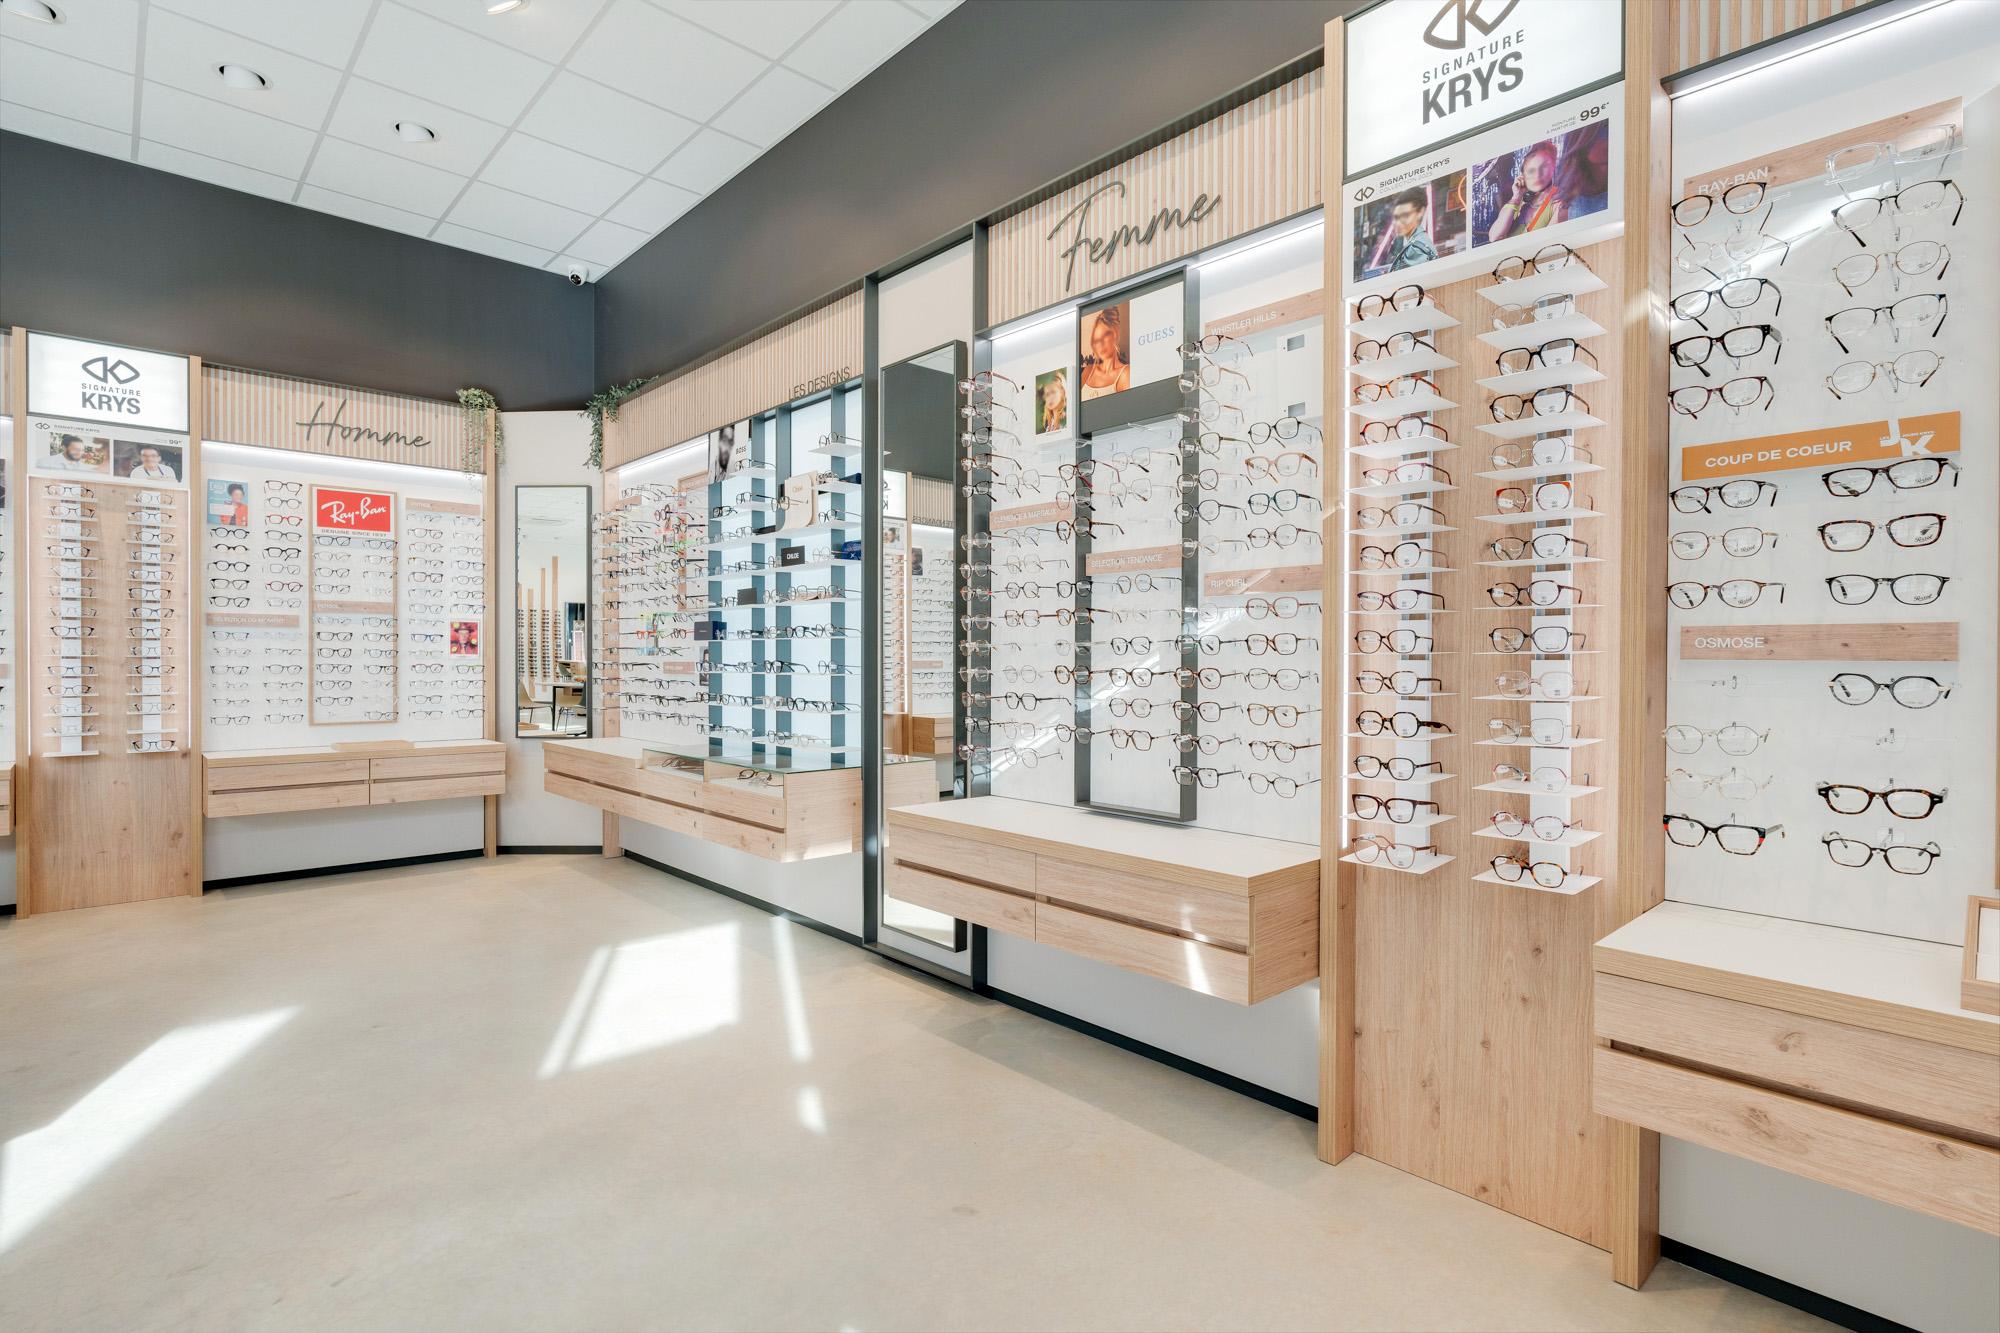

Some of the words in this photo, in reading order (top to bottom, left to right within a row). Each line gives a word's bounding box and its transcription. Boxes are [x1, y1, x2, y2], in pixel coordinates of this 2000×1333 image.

[1422, 29, 1525, 84] SIGNATURE
[1422, 51, 1525, 125] KRYS
[1379, 167, 1426, 188] SIGNATURE
[1427, 158, 1450, 171] KRYS
[1698, 166, 1769, 195] RAY-BAN
[1047, 181, 1222, 292] Femme
[1137, 326, 1175, 346] GUESS
[1211, 318, 1251, 335] WHISTLER
[1253, 310, 1277, 325] HILLS
[81, 383, 141, 396] SIGNATURE
[807, 366, 850, 392] DESIGNS
[81, 391, 141, 415] KRYS
[296, 399, 431, 447] Homme
[1704, 453, 1754, 468] COUP
[1757, 450, 1782, 462] DE
[1786, 441, 1852, 458] COEUR
[321, 497, 387, 526] Ray-Ban
[1211, 580, 1224, 589] RIP
[1695, 637, 1765, 649] OSMOSE
